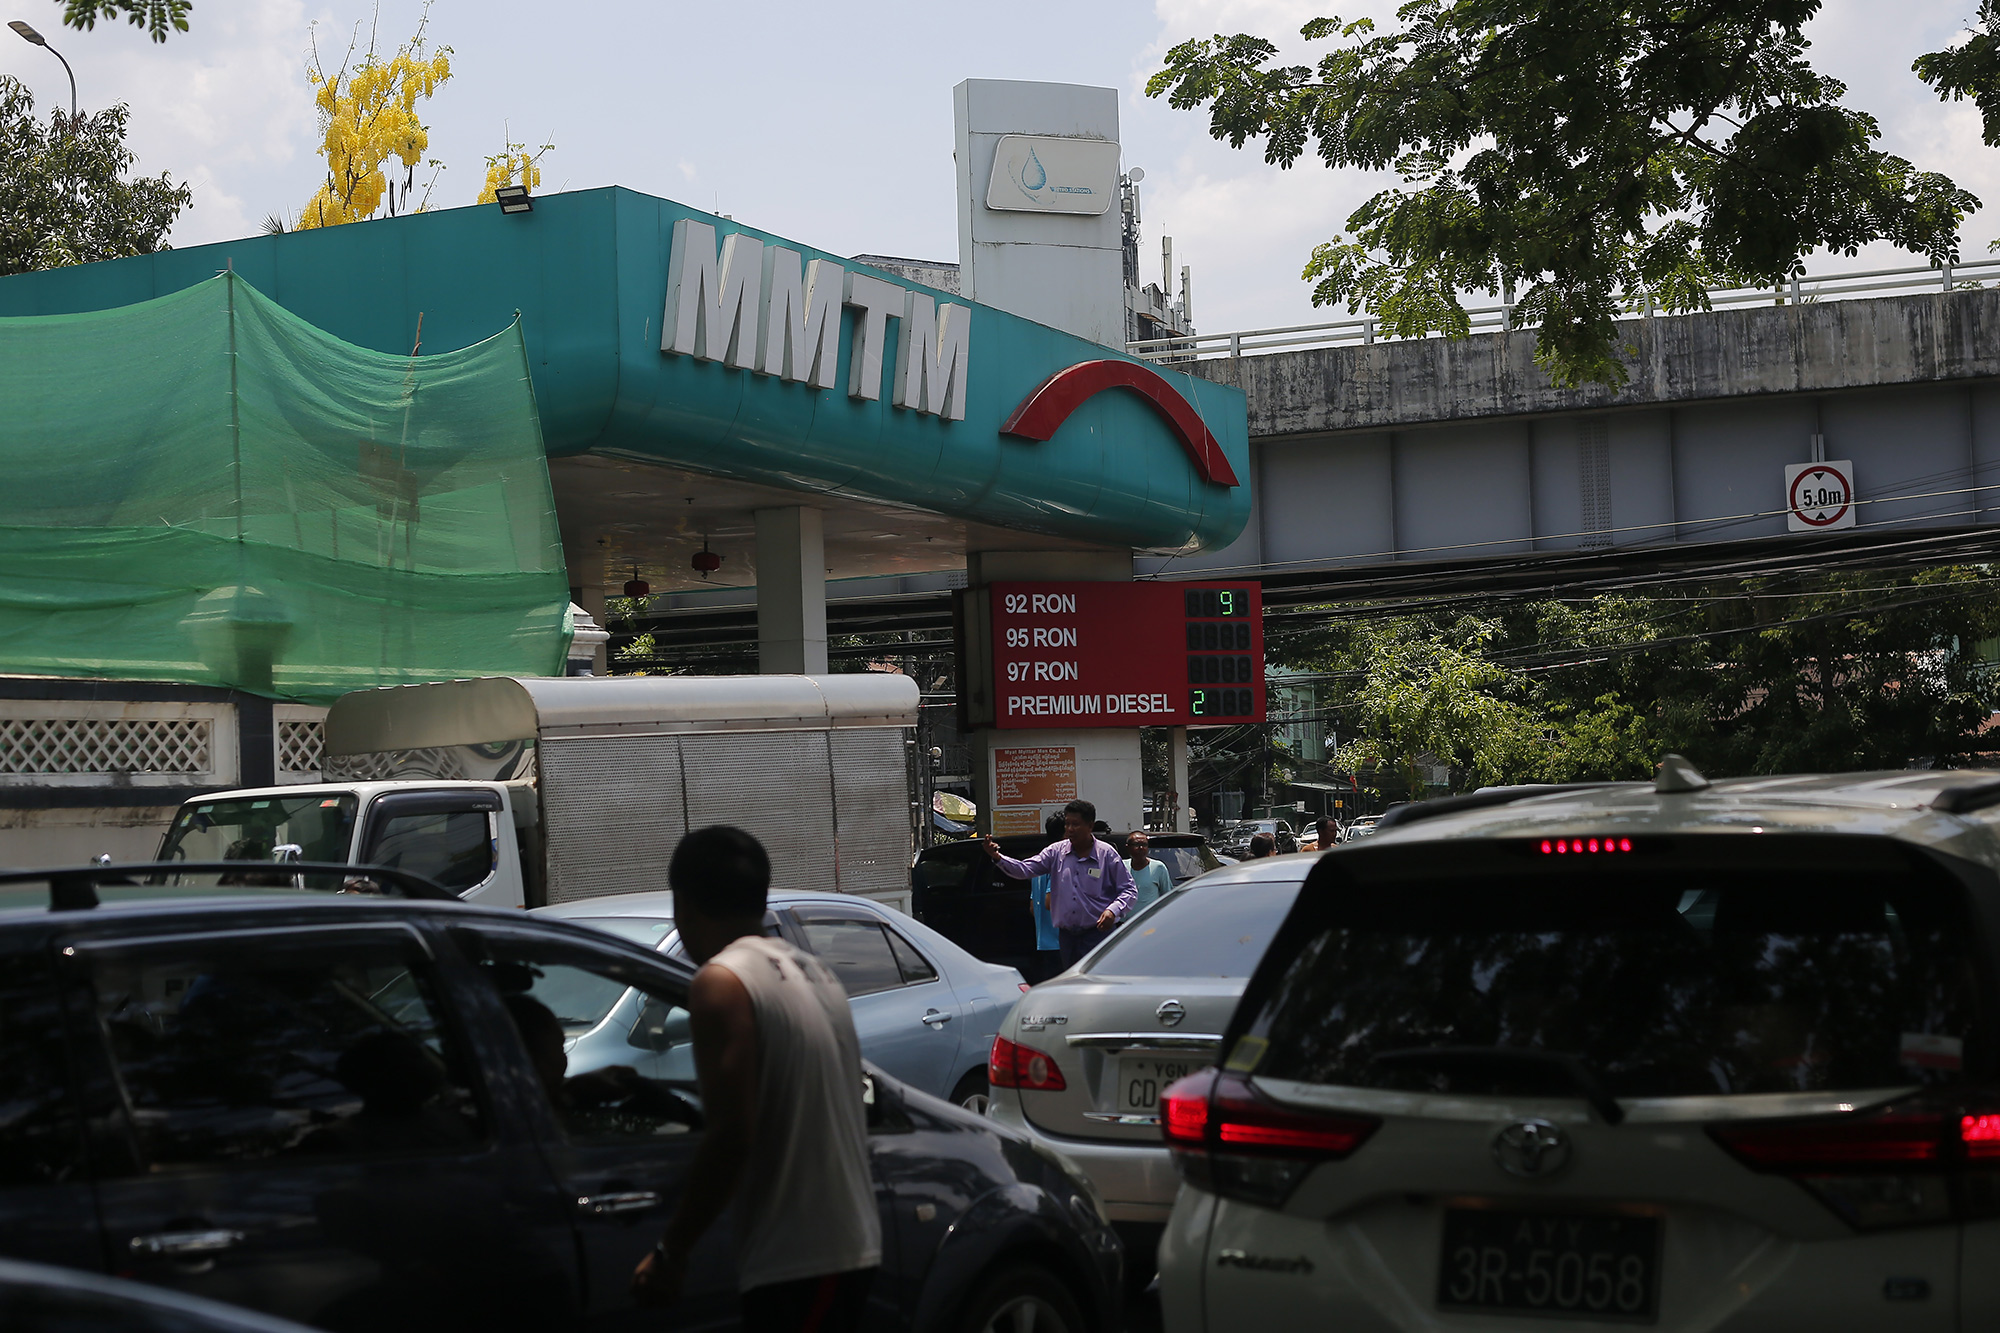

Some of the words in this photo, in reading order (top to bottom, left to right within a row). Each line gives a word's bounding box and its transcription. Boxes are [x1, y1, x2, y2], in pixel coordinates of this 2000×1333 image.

[660, 218, 971, 421] MMTM
[1803, 488, 1842, 507] 5.0m
[1005, 594, 1028, 614] 92
[1032, 594, 1076, 614] RON
[1220, 591, 1233, 615] 9
[1006, 628, 1029, 648] 95
[1034, 627, 1077, 647] RON
[1007, 662, 1030, 682] 97
[1034, 661, 1079, 681] RON
[1008, 695, 1101, 716] PREMIUM
[1106, 694, 1175, 714] DIESEL
[1192, 690, 1205, 715] 2
[1154, 1063, 1188, 1078] YGN
[1513, 1217, 1584, 1246] AYY
[1449, 1246, 1645, 1312] 3R-5058
